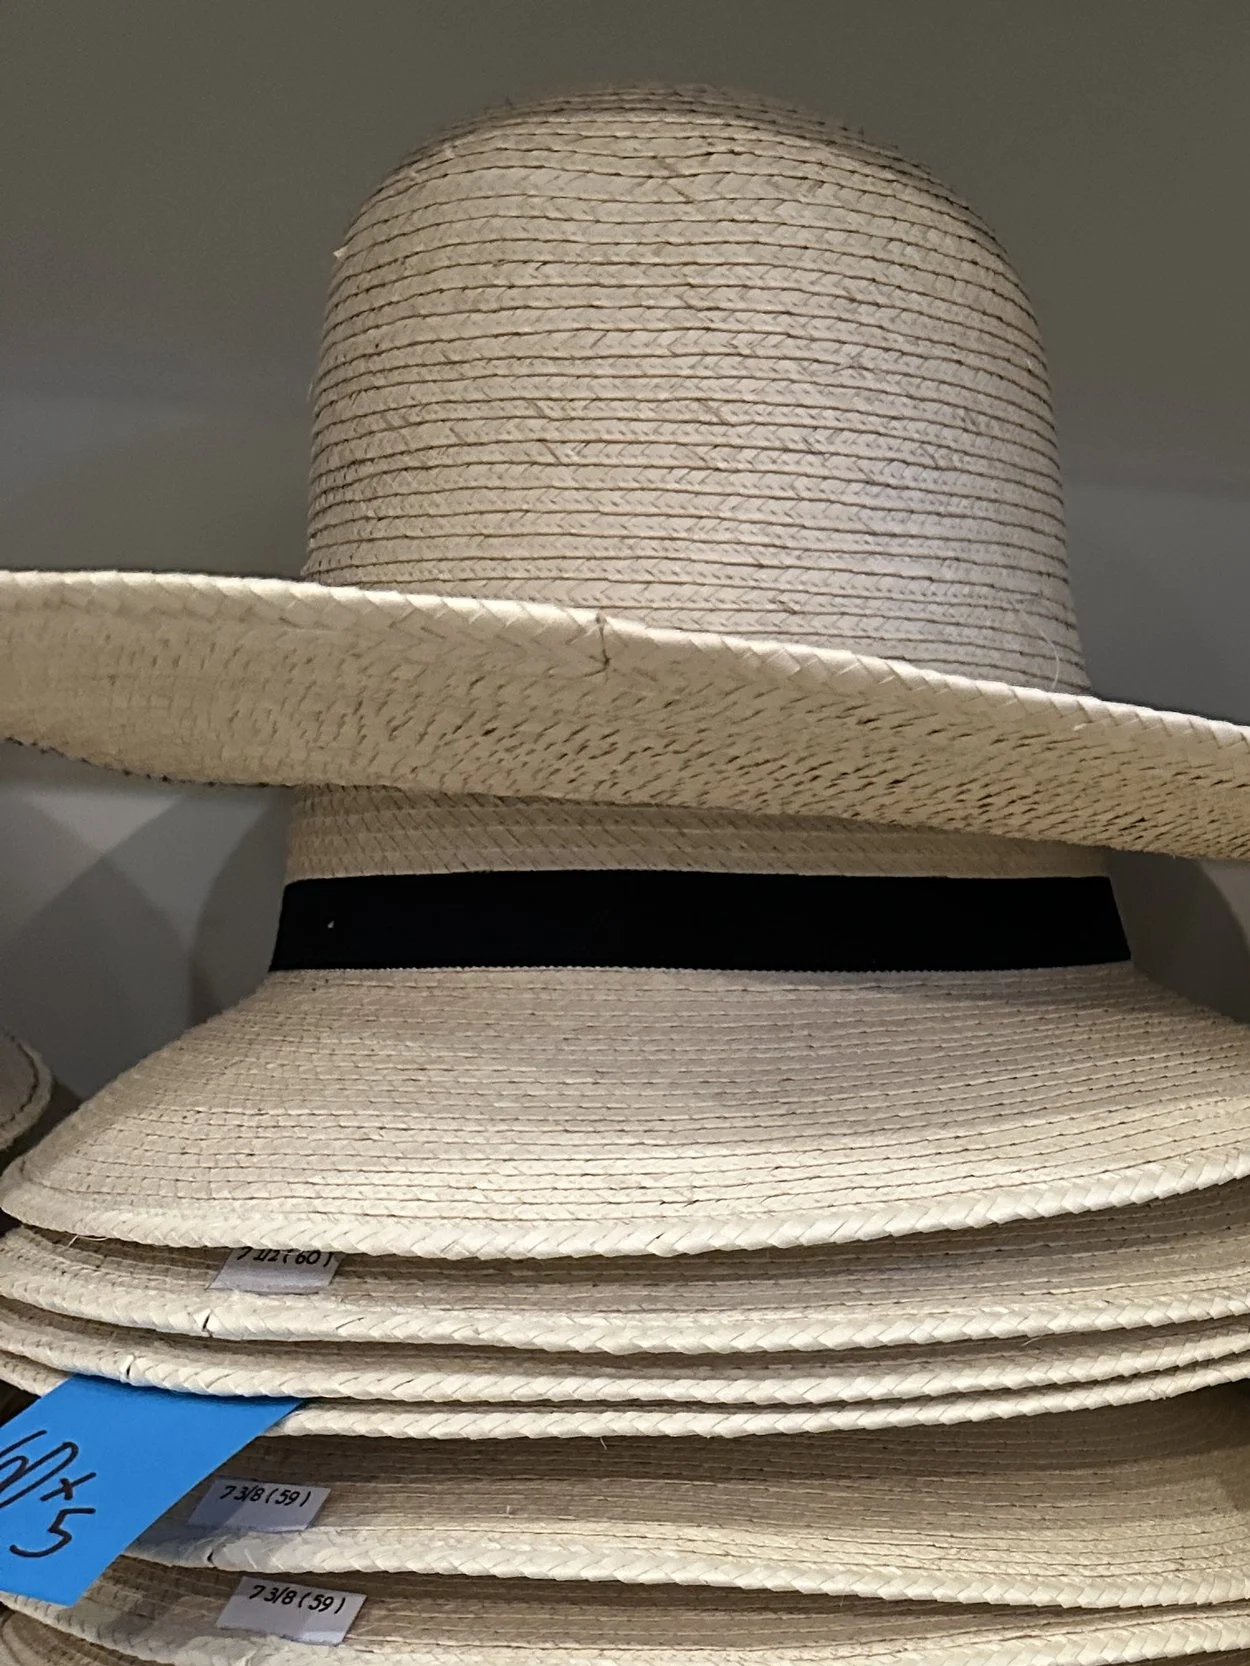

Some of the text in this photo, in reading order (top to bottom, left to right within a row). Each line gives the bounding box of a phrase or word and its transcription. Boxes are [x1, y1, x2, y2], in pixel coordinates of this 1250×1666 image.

[219, 1485, 311, 1507] 7 3/8 (59)
[9, 1507, 97, 1558] 5
[249, 1584, 346, 1614] 7 3/8 (59)
